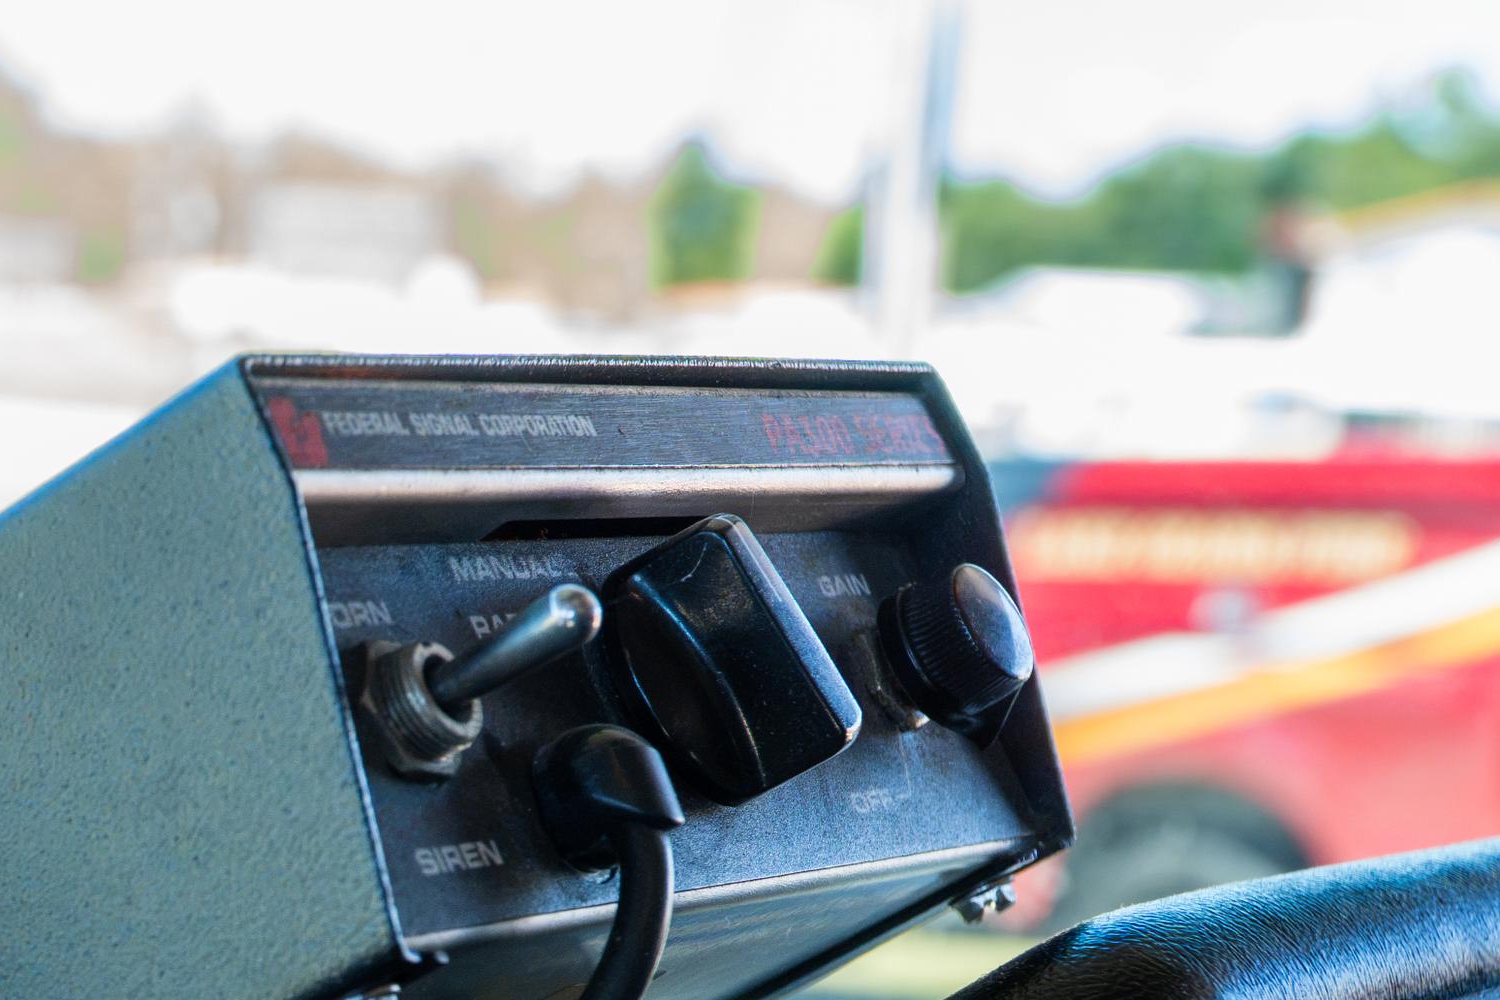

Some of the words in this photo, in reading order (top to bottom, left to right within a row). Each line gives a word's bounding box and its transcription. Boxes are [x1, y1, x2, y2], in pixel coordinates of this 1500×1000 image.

[321, 411, 409, 436] FEDERAL
[409, 412, 478, 437] SIGNAL
[479, 412, 598, 437] CORPORATION
[819, 573, 872, 598] GAIN
[329, 600, 393, 628] ORN
[414, 839, 504, 877] SIREN
